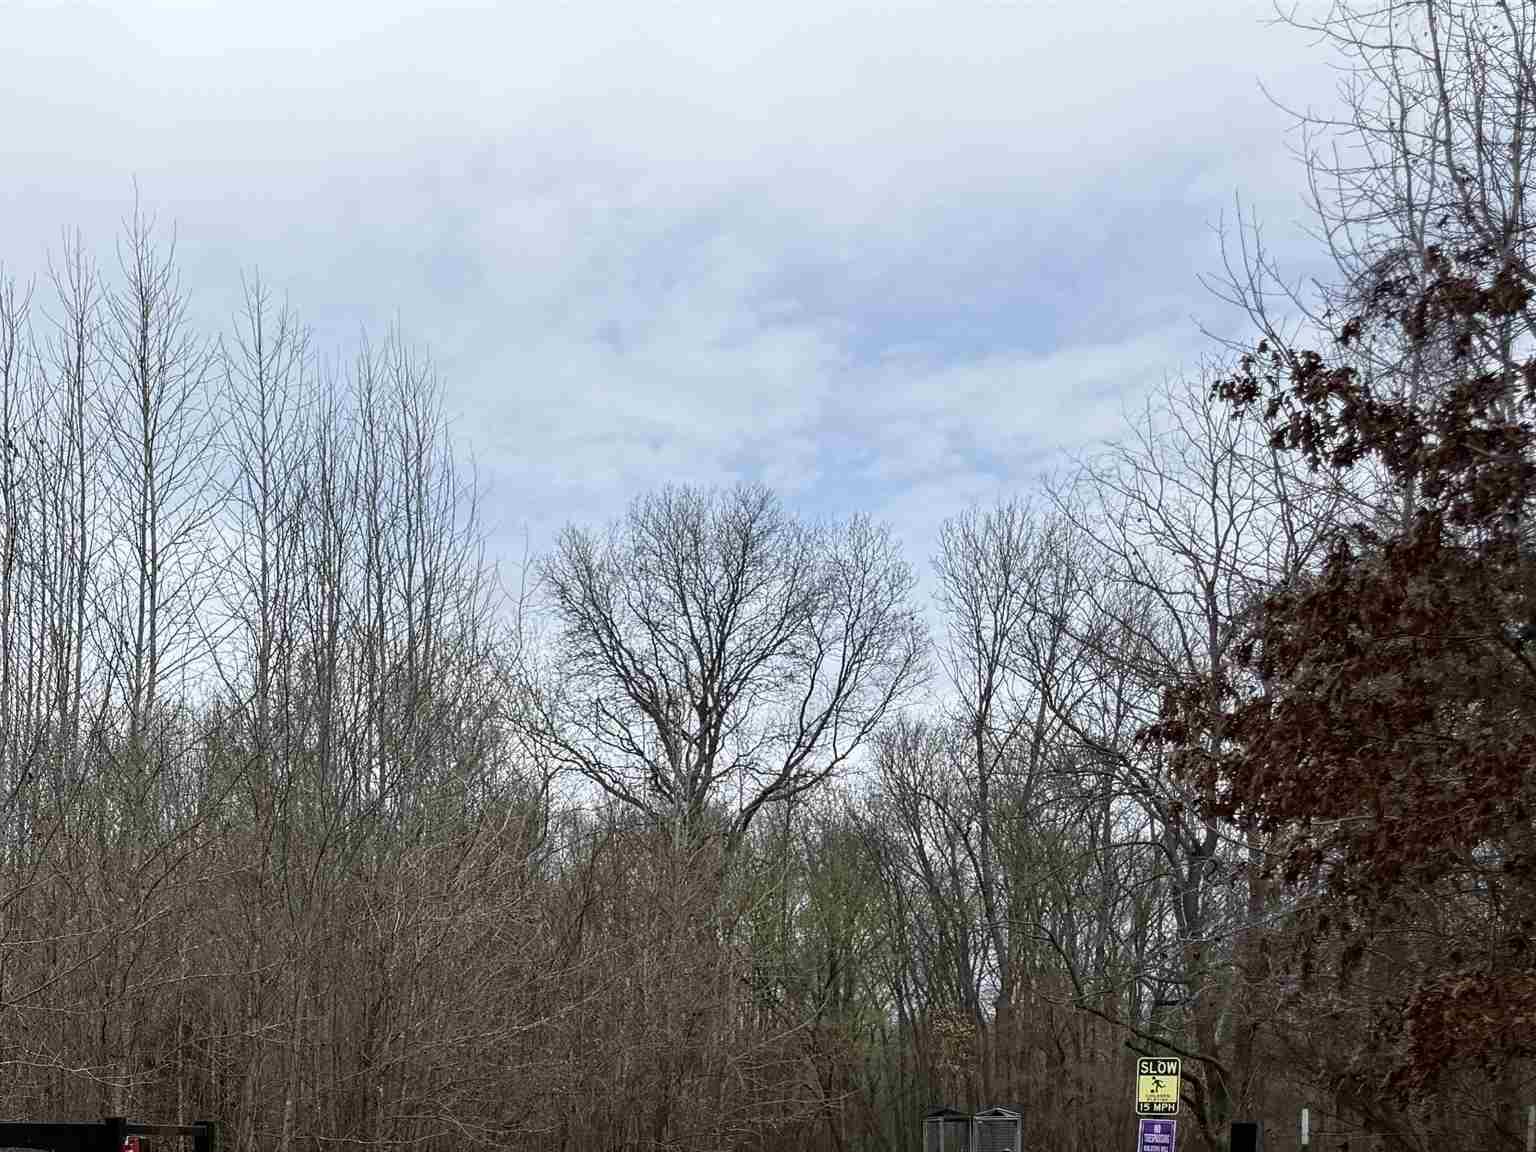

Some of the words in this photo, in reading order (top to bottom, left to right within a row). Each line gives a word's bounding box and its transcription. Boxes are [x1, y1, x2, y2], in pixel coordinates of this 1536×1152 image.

[1141, 1061, 1177, 1075] SLOW
[1140, 1103, 1150, 1112] 15
[1153, 1103, 1175, 1112] MPH
